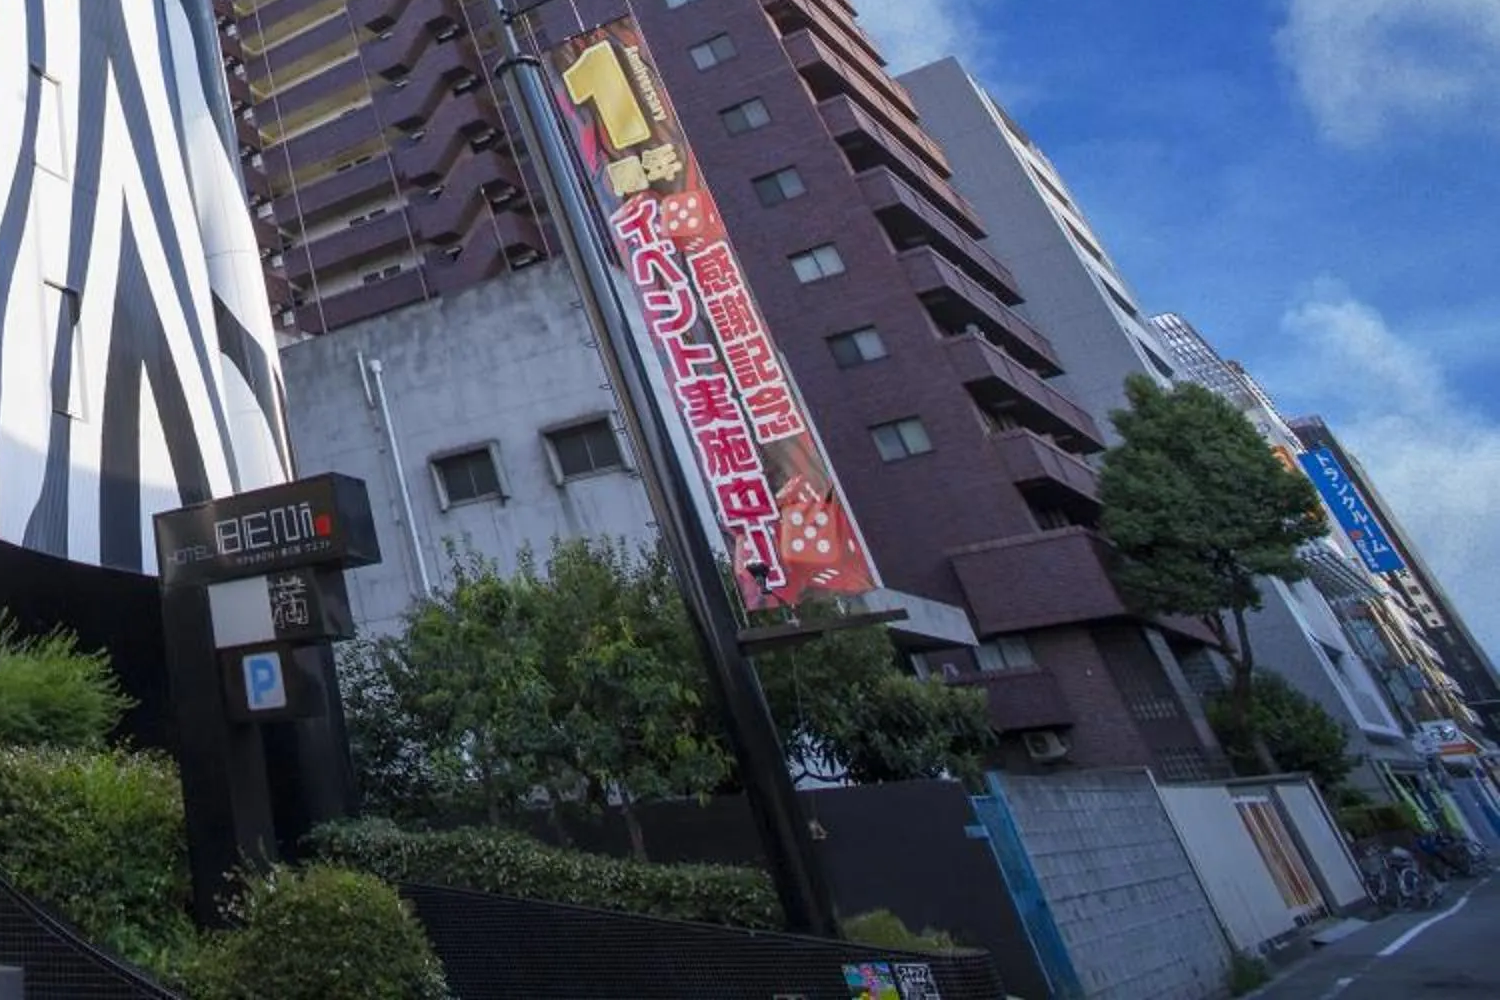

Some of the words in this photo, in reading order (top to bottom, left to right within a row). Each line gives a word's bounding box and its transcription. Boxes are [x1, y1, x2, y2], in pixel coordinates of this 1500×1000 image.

[564, 40, 651, 149] 1
[625, 45, 668, 122] Anniversary
[690, 240, 806, 443] 感謝記念
[250, 658, 275, 704] P
